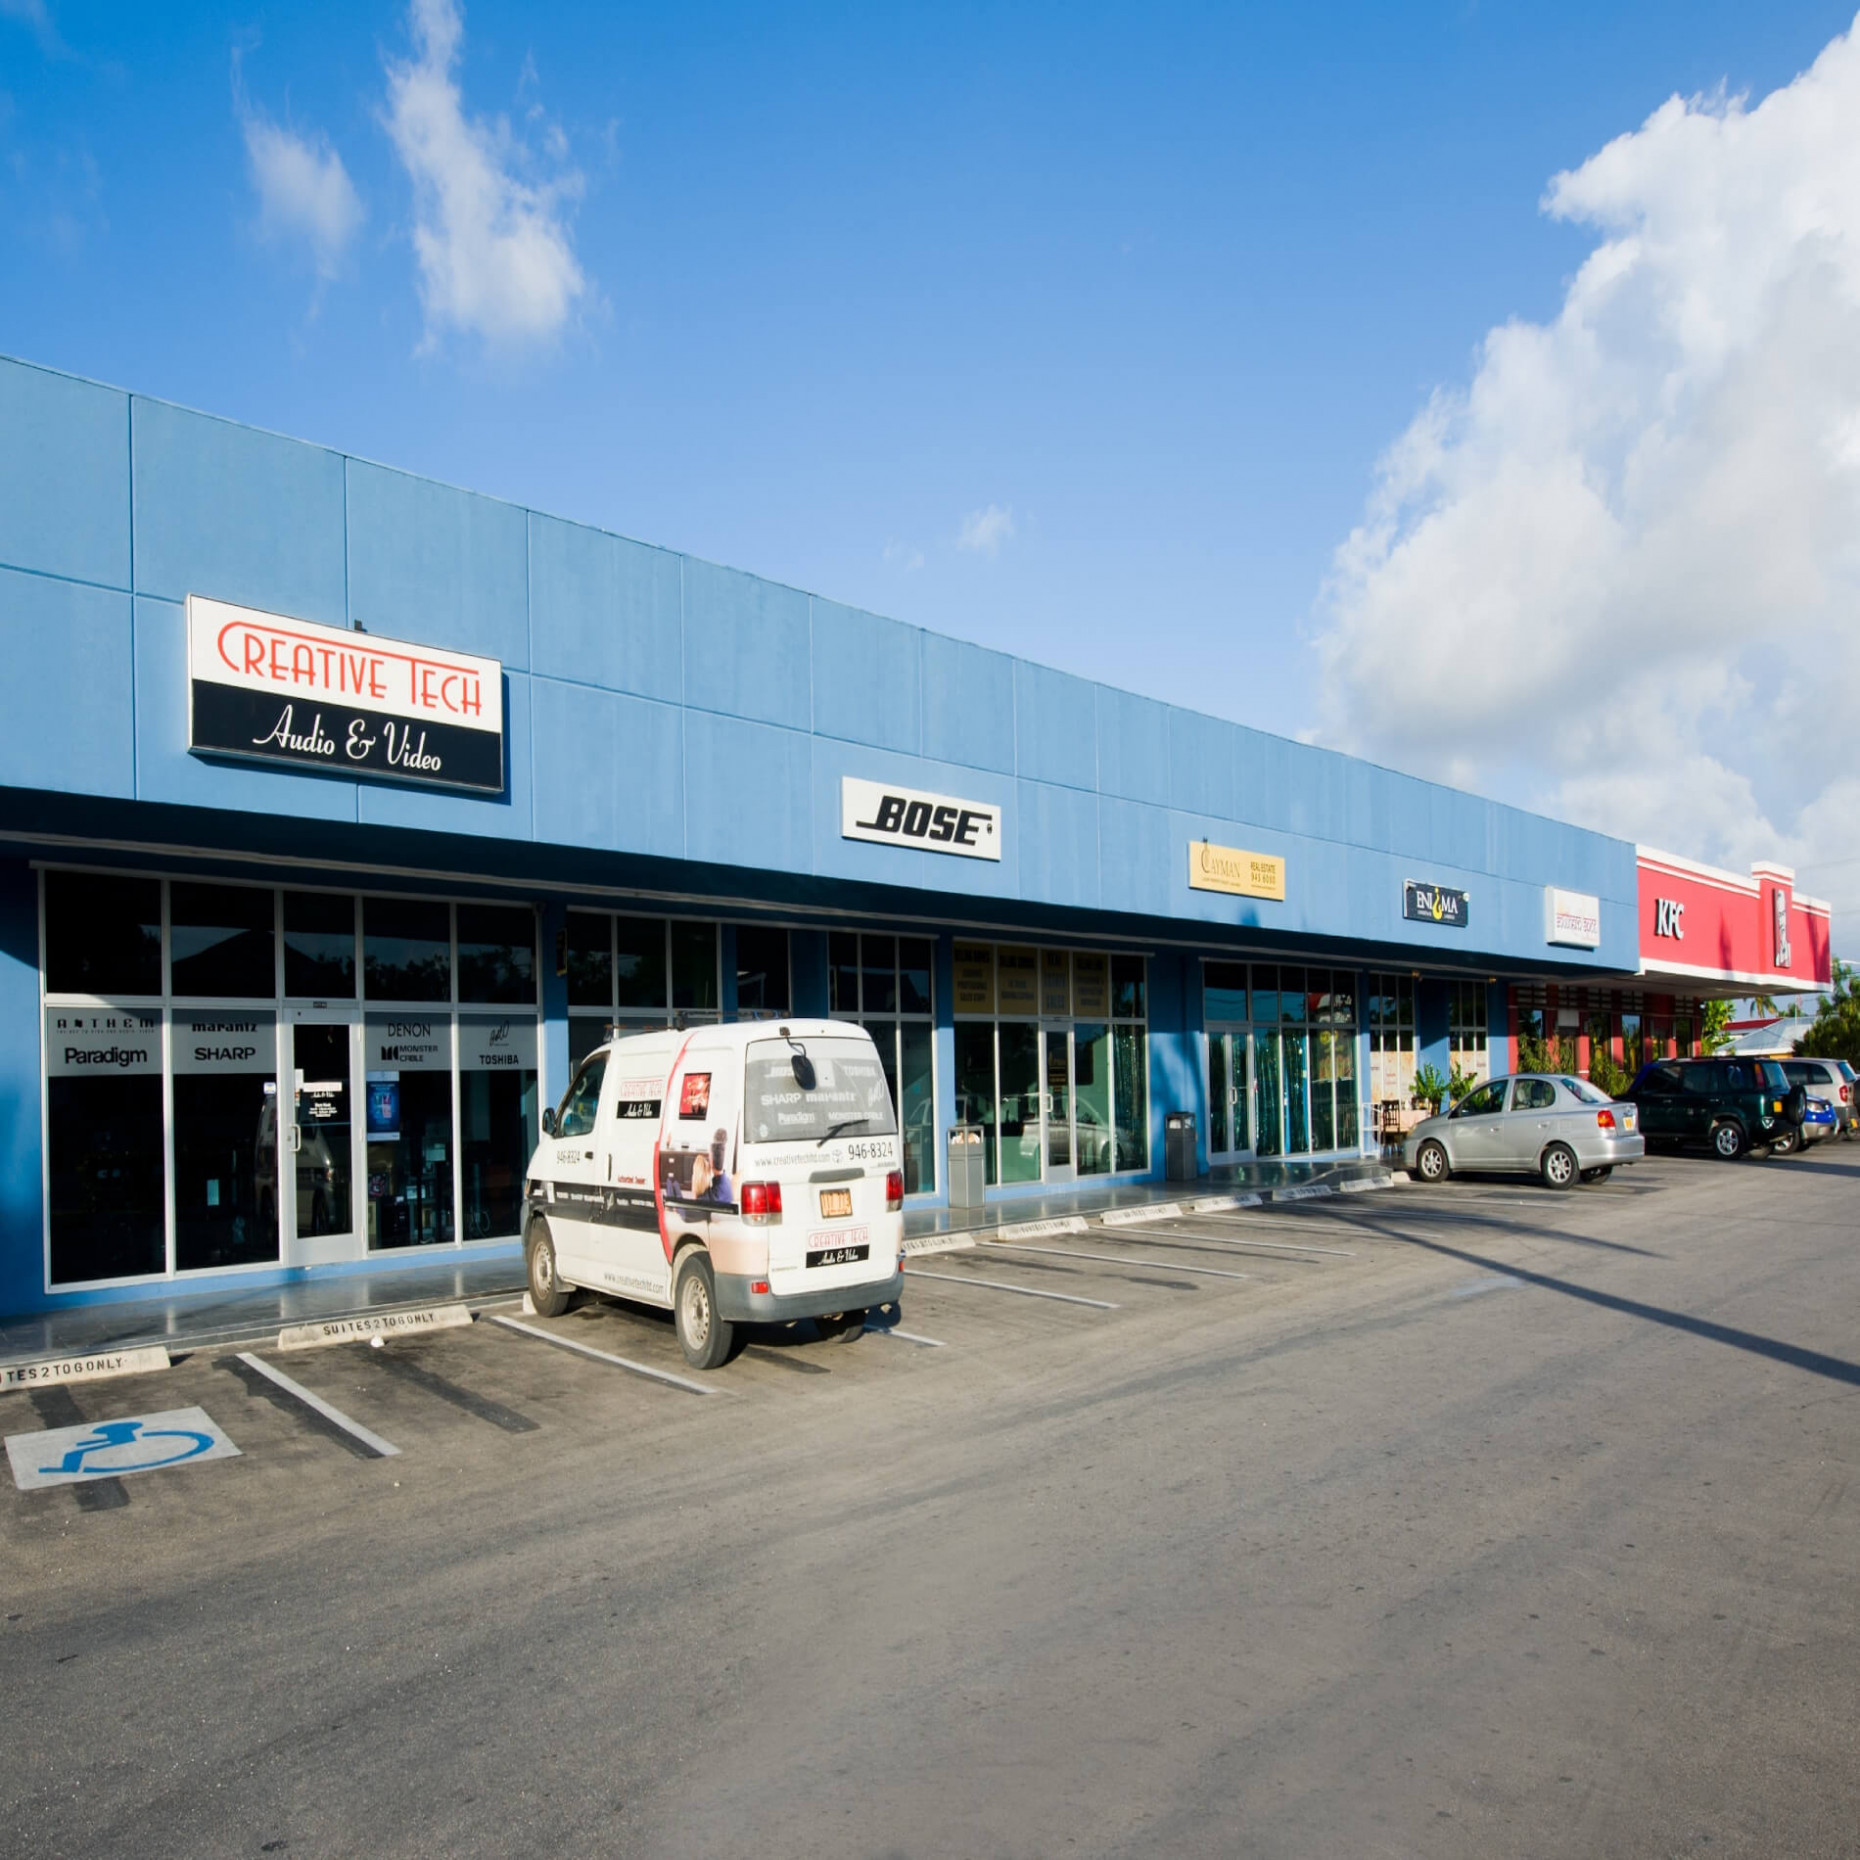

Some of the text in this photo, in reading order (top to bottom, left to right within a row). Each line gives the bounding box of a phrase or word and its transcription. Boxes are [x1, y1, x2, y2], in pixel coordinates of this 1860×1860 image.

[217, 621, 482, 717] CREATIVE TECH
[252, 704, 442, 772] Audio & Video
[855, 795, 993, 846] BOSE
[1656, 898, 1684, 940] KFC
[57, 1018, 154, 1029] ANTHEM
[192, 1022, 258, 1033] marantz
[388, 1023, 431, 1037] DENON
[194, 1047, 256, 1061] SHARP
[399, 1045, 438, 1053] MONSTER
[64, 1046, 148, 1067] Paradigm
[479, 1055, 519, 1065] TOSHIBA
[761, 1093, 801, 1106] SHARP
[848, 1142, 893, 1160] 946-8324
